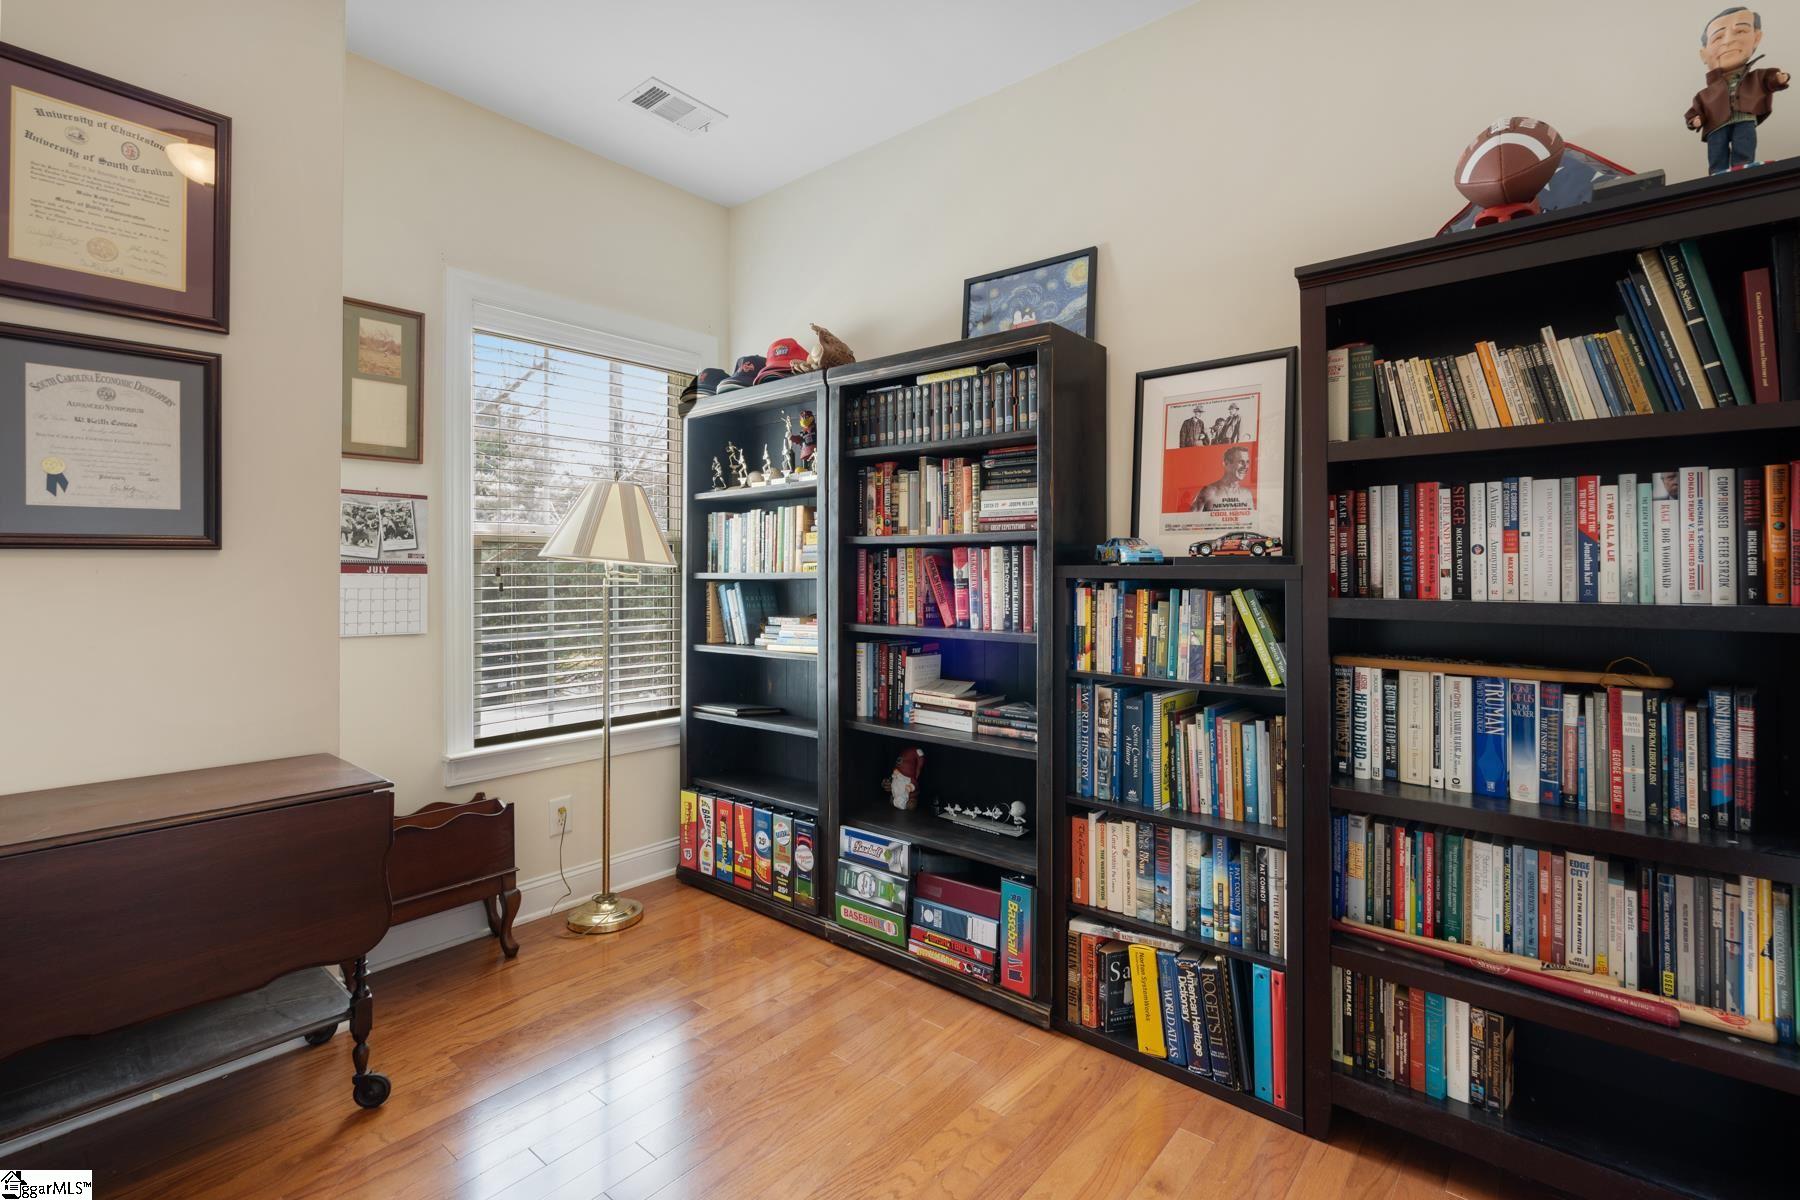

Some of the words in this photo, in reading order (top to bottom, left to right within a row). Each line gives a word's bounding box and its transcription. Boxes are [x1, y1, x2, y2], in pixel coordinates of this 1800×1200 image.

[34, 108, 93, 131] University
[97, 121, 107, 134] of
[111, 124, 166, 152] Charleston
[24, 129, 79, 159] University
[83, 153, 95, 162] of
[98, 157, 128, 170] South
[132, 164, 174, 178] Carolina
[1668, 255, 1680, 273] Aiken
[1674, 274, 1686, 290] High
[1681, 290, 1696, 312] School
[1357, 492, 1366, 524] RUSSIAN
[1442, 496, 1450, 516] FIRE
[1452, 486, 1466, 526] SIEGE
[1489, 494, 1498, 528] Warning
[1718, 476, 1729, 529] COMPROMISED
[1357, 524, 1366, 557] ROULETTE
[1403, 530, 1412, 550] DEEP
[1442, 520, 1450, 540] AND
[1662, 528, 1672, 543] BOB
[1748, 530, 1757, 556] MICHAEL
[1443, 542, 1451, 563] FURY
[1584, 542, 1592, 570] Jonathan
[1688, 543, 1696, 566] UNITED
[1718, 536, 1730, 558] PETER
[366, 566, 390, 574] JULY
[1403, 556, 1412, 582] STATE
[1489, 538, 1499, 584] Anonymous
[1662, 546, 1672, 588] WOODWARD
[1718, 560, 1730, 588] STRZOK
[1748, 556, 1757, 576] COHEN
[1584, 572, 1592, 586] Karl
[1688, 568, 1696, 590] STATES
[1249, 600, 1260, 617] Wrack
[1256, 617, 1266, 628] Line
[1268, 642, 1280, 661] Patrick
[1336, 678, 1350, 714] MODERN
[1355, 694, 1367, 719] HEAD
[1384, 684, 1396, 710] BOUND
[1484, 682, 1504, 736] TRUMAN
[1714, 695, 1730, 717] RUSH
[1336, 718, 1350, 742] TIMES
[1355, 722, 1367, 732] TO
[1384, 713, 1396, 722] TO
[1648, 718, 1656, 728] UP
[1738, 709, 1754, 726] RUSH
[1132, 724, 1141, 746] SOUTH
[1355, 734, 1367, 760] HEAD
[1384, 724, 1396, 744] LEAD
[1713, 718, 1731, 759] LIMBAUGH
[1738, 728, 1754, 759] LIMBAUGH
[1081, 736, 1089, 781] HISTORY
[1132, 747, 1141, 778] CAROLINA
[1612, 749, 1621, 774] GEORGE
[1612, 776, 1621, 784] W.
[1613, 785, 1622, 802] BUSH
[1570, 860, 1590, 870] EDGE
[1570, 869, 1590, 878] CITY
[843, 908, 880, 929] BASEBALL
[1008, 900, 1018, 956] Baseball
[1273, 910, 1280, 920] ME
[1069, 936, 1078, 970] BERLIN
[1776, 910, 1787, 986] MICROECONOMICS
[1664, 974, 1672, 992] USED
[1069, 986, 1078, 1007] 1961
[1141, 976, 1151, 1022] SystemWorks
[1164, 989, 1175, 1024] WORLD
[1178, 976, 1190, 1022] Dictionary
[1202, 974, 1222, 1032] ROGET'S
[1186, 970, 1198, 1014] American
[1193, 1016, 1204, 1056] Heritage
[1168, 1024, 1178, 1058] ATLAS
[1210, 1036, 1223, 1046] II
